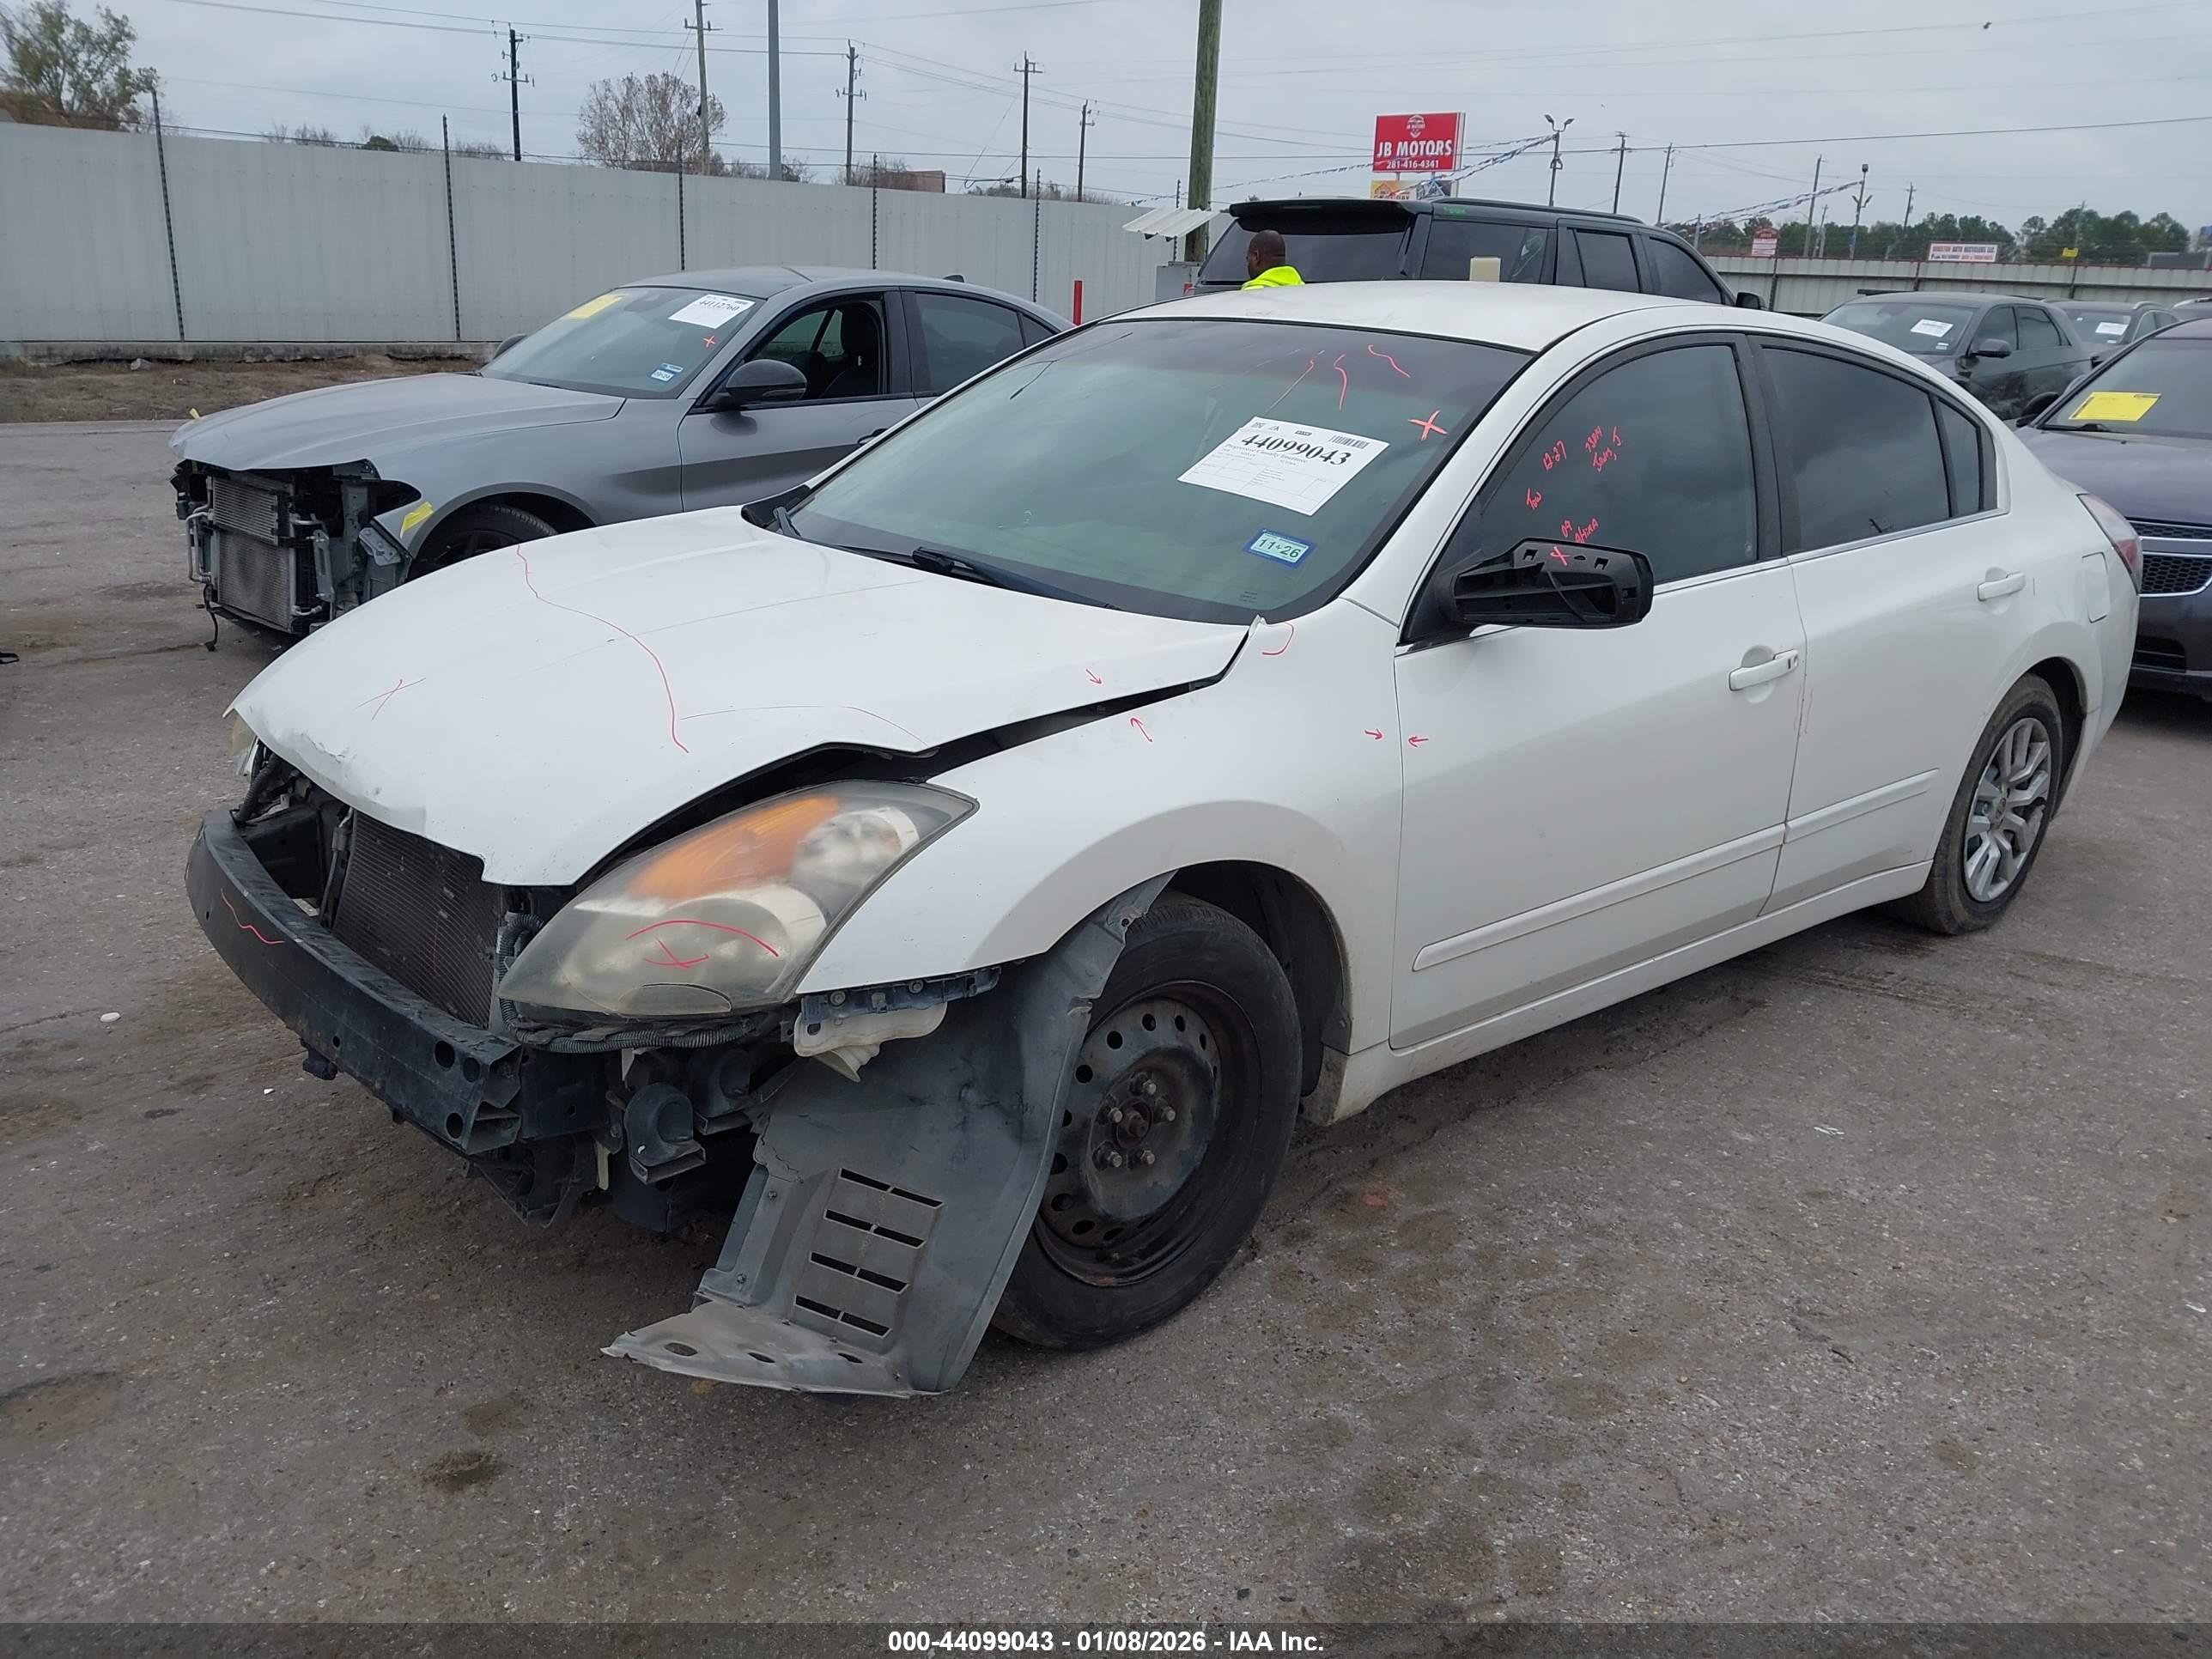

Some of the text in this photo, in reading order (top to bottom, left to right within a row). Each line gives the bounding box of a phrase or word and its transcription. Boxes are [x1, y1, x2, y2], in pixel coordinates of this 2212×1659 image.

[1376, 139, 1453, 158] JB MOTORS
[1386, 159, 1439, 170] 281-416-4341
[1241, 434, 1352, 465] 44099043
